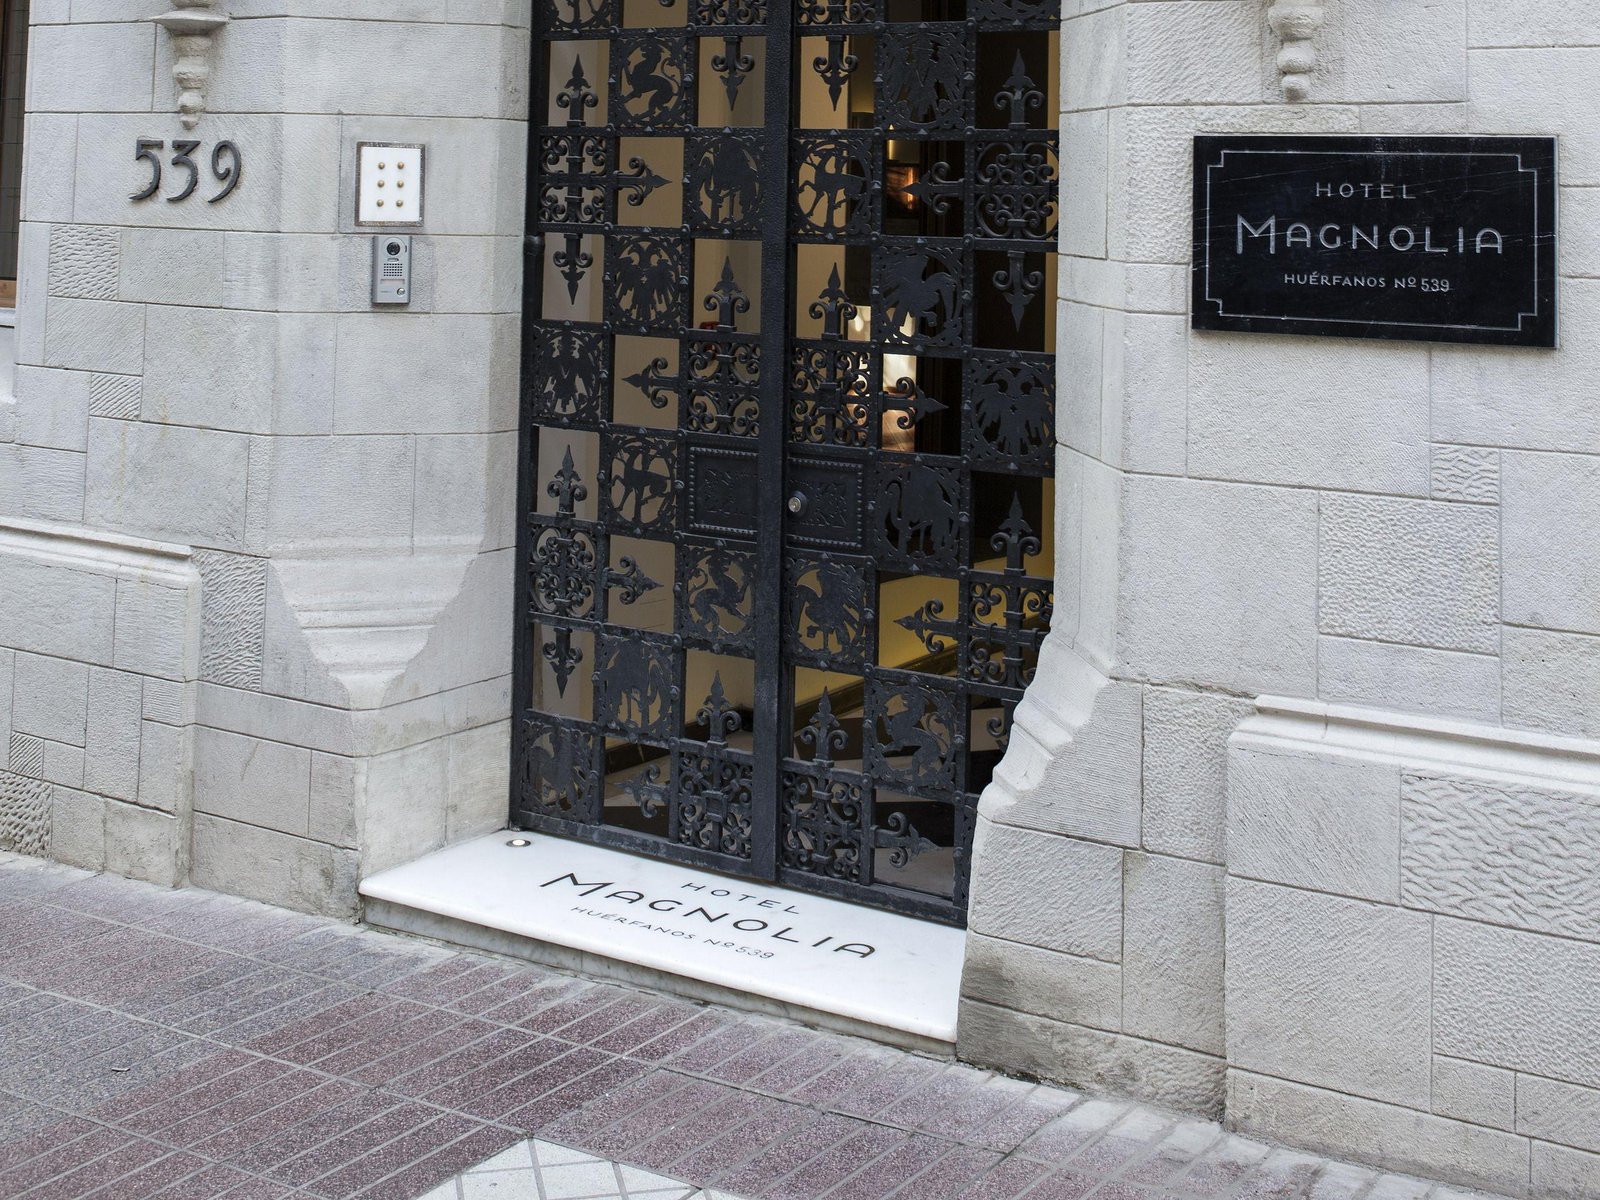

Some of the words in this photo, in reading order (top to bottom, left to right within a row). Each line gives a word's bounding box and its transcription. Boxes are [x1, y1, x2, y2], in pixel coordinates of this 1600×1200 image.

[129, 139, 242, 204] 539
[1315, 182, 1416, 200] HOTEL
[1236, 213, 1503, 256] MAGNOLIA
[1284, 271, 1386, 289] HUÉRFANOS
[1420, 278, 1450, 293] 539
[539, 872, 876, 959] MAGNOLIA
[680, 882, 801, 915] HOTEL
[570, 906, 697, 940] HUÉRFANOS
[735, 946, 775, 959] 539
